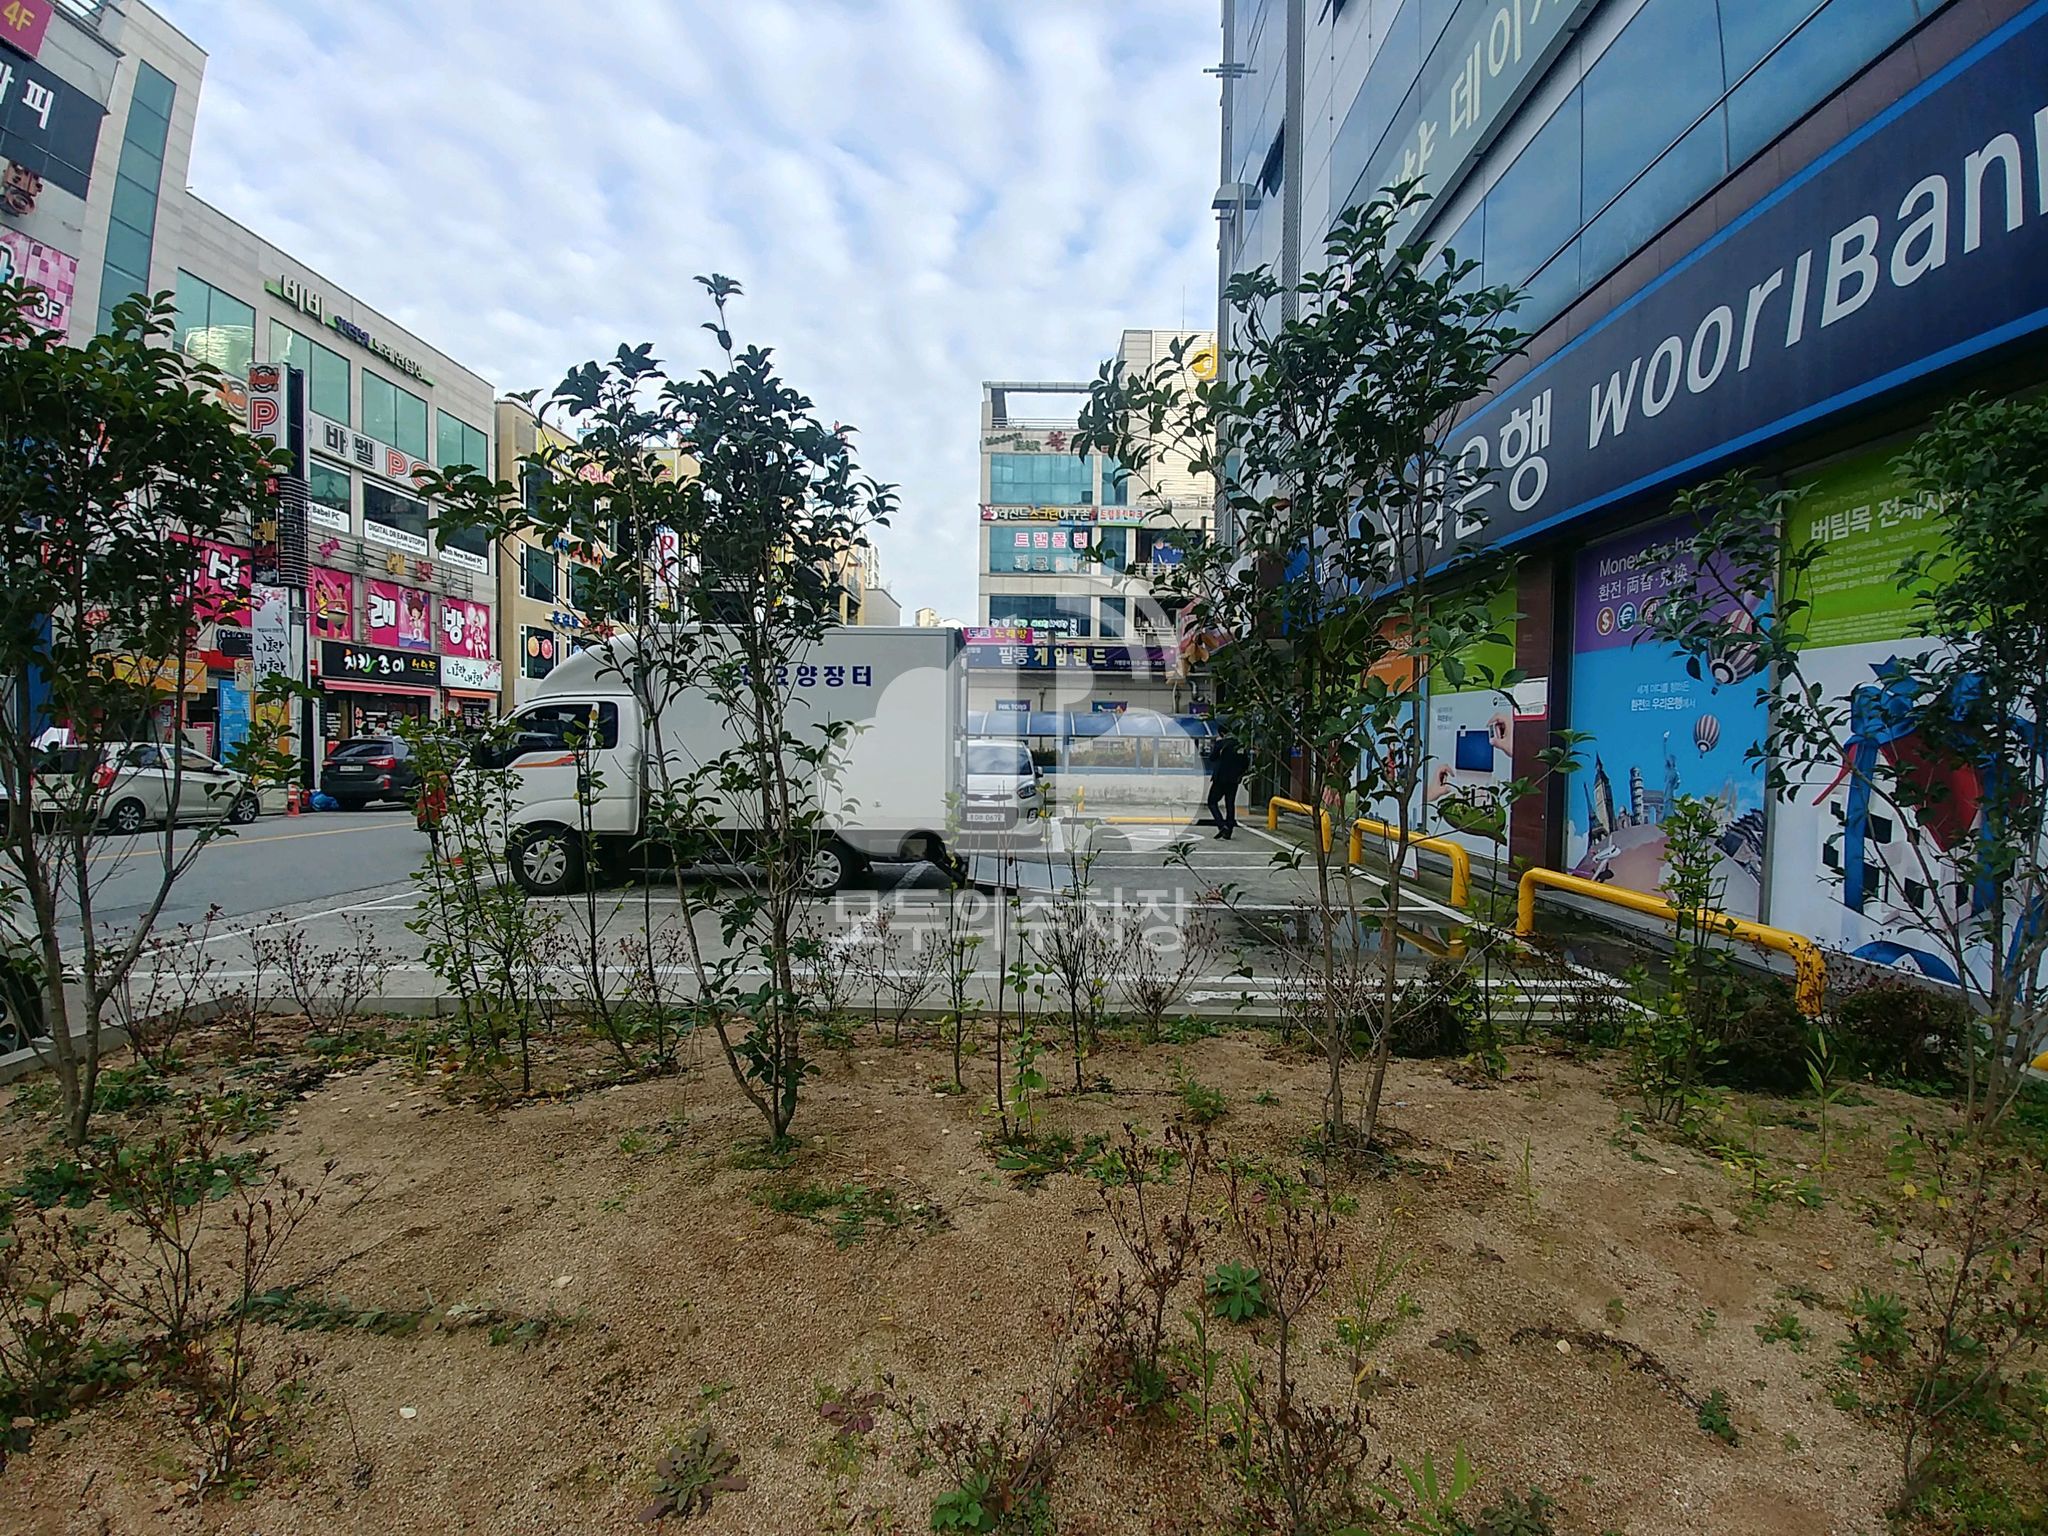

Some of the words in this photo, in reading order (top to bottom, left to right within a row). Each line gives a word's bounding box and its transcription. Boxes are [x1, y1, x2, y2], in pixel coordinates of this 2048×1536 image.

[3, 1, 36, 32] 4F
[33, 291, 62, 322] 3F
[324, 421, 375, 469] 바벨
[1811, 504, 1873, 543] 버팀목
[369, 594, 396, 628] 래
[441, 606, 465, 645] 방
